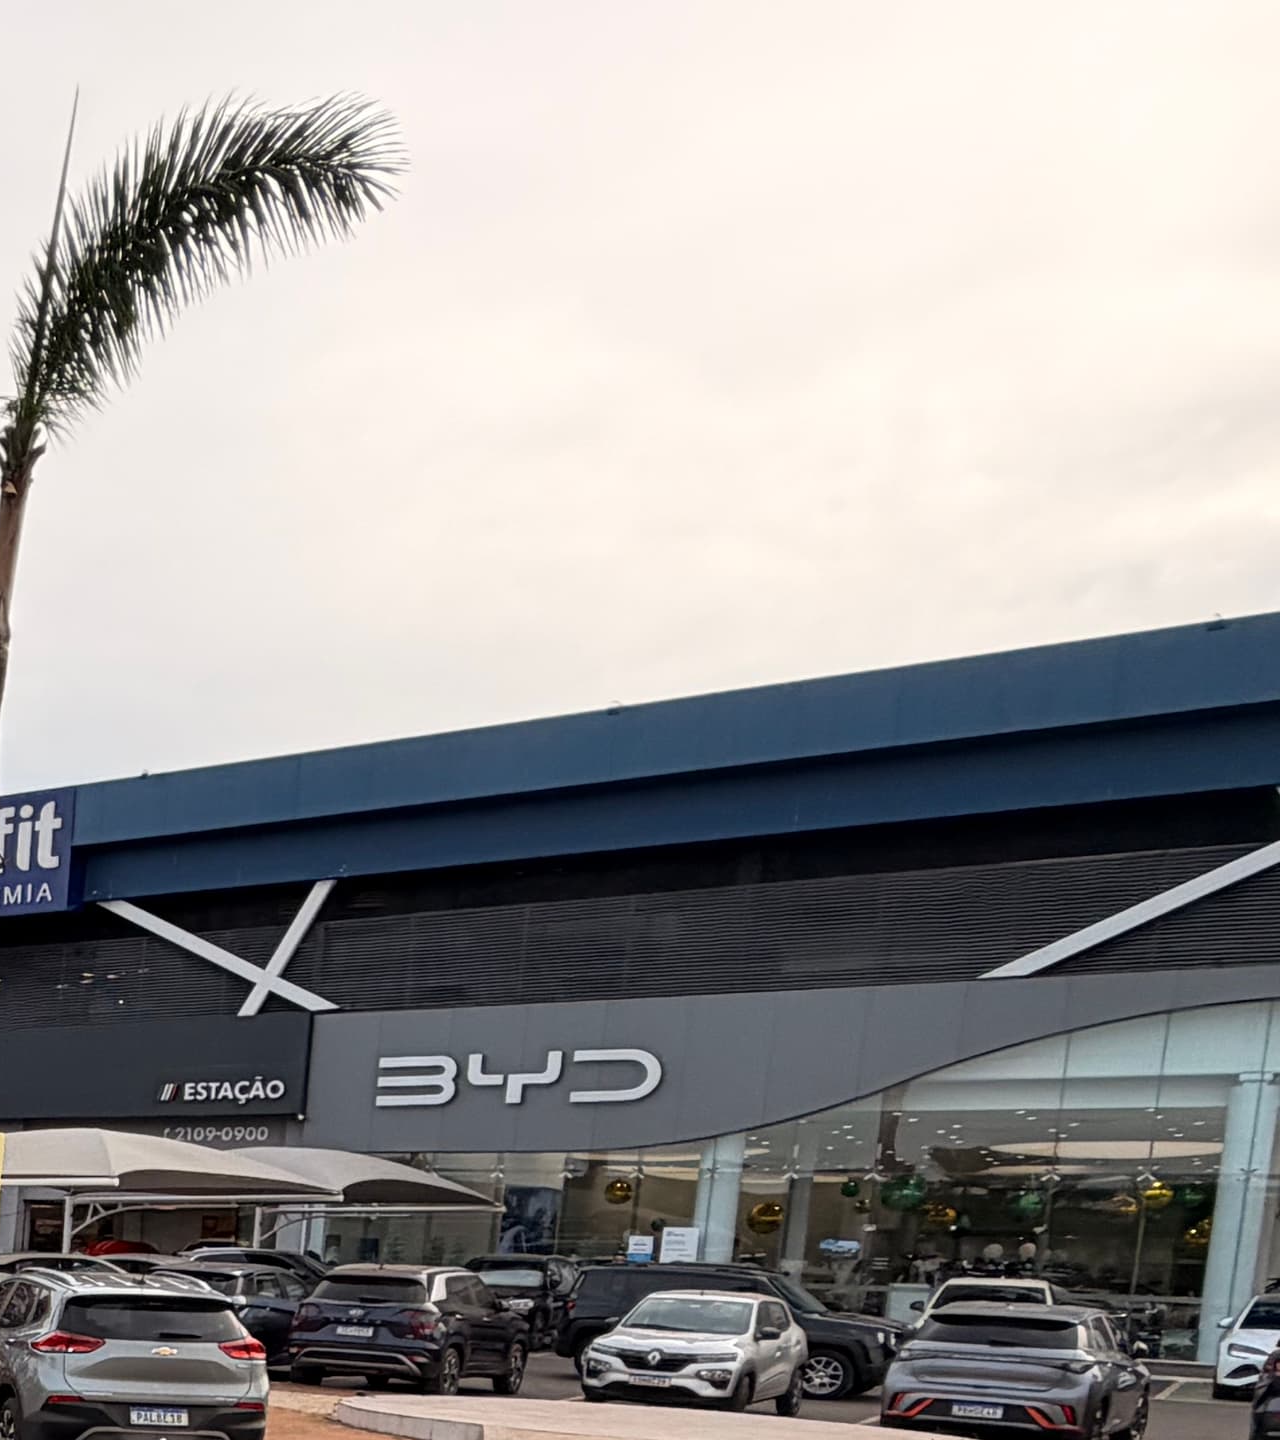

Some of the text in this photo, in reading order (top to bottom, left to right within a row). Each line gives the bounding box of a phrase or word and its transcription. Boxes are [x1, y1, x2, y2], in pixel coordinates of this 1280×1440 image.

[183, 1076, 285, 1104] ESTAÇÃO
[376, 1048, 662, 1106] BYD
[175, 1126, 269, 1142] 2109-0900
